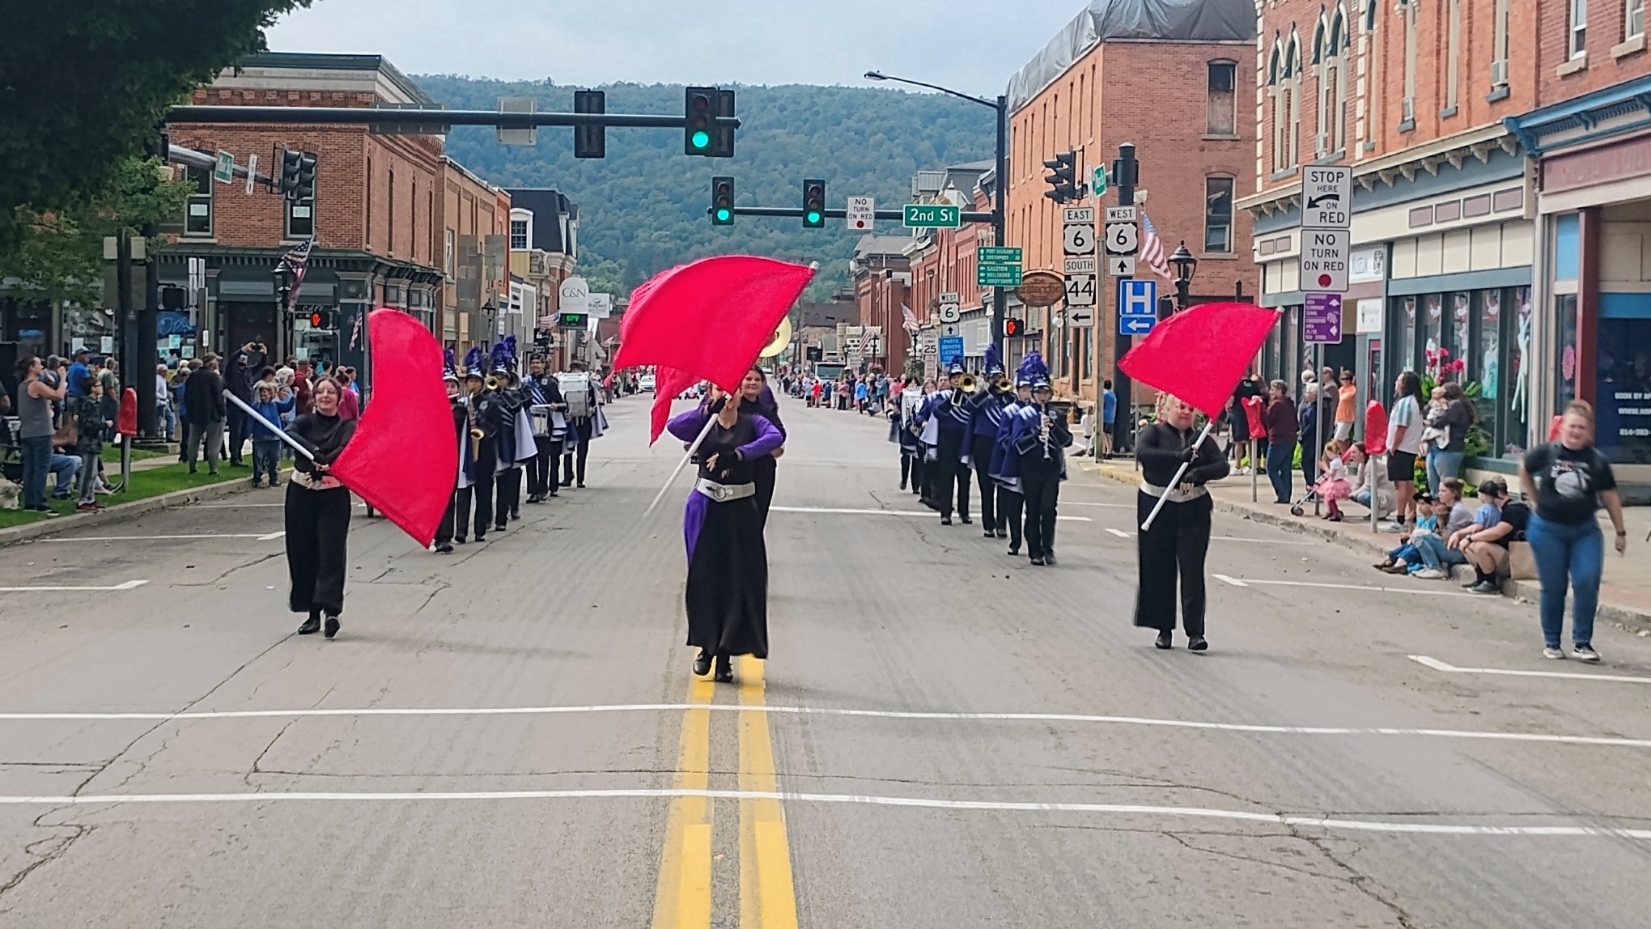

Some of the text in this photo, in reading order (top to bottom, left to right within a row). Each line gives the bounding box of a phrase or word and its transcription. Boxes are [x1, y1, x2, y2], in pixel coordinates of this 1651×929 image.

[1311, 171, 1344, 183] STOP
[910, 208, 954, 221] 2nd St
[1067, 210, 1090, 220] EAST
[1110, 209, 1133, 218] WEST
[1319, 212, 1345, 223] RED
[1073, 230, 1084, 247] 6
[1116, 228, 1127, 245] 6
[1315, 234, 1336, 246] NO
[1311, 248, 1338, 258] TURN
[1066, 260, 1093, 270] SOUTH
[1303, 261, 1319, 271] ON
[1324, 261, 1344, 271] RED
[562, 287, 587, 298] C&N
[1067, 281, 1093, 297] 44
[1126, 282, 1152, 314] H
[945, 307, 954, 318] 6
[924, 345, 937, 353] 25
[1614, 392, 1632, 400] BOOK
[1633, 392, 1643, 400] BY
